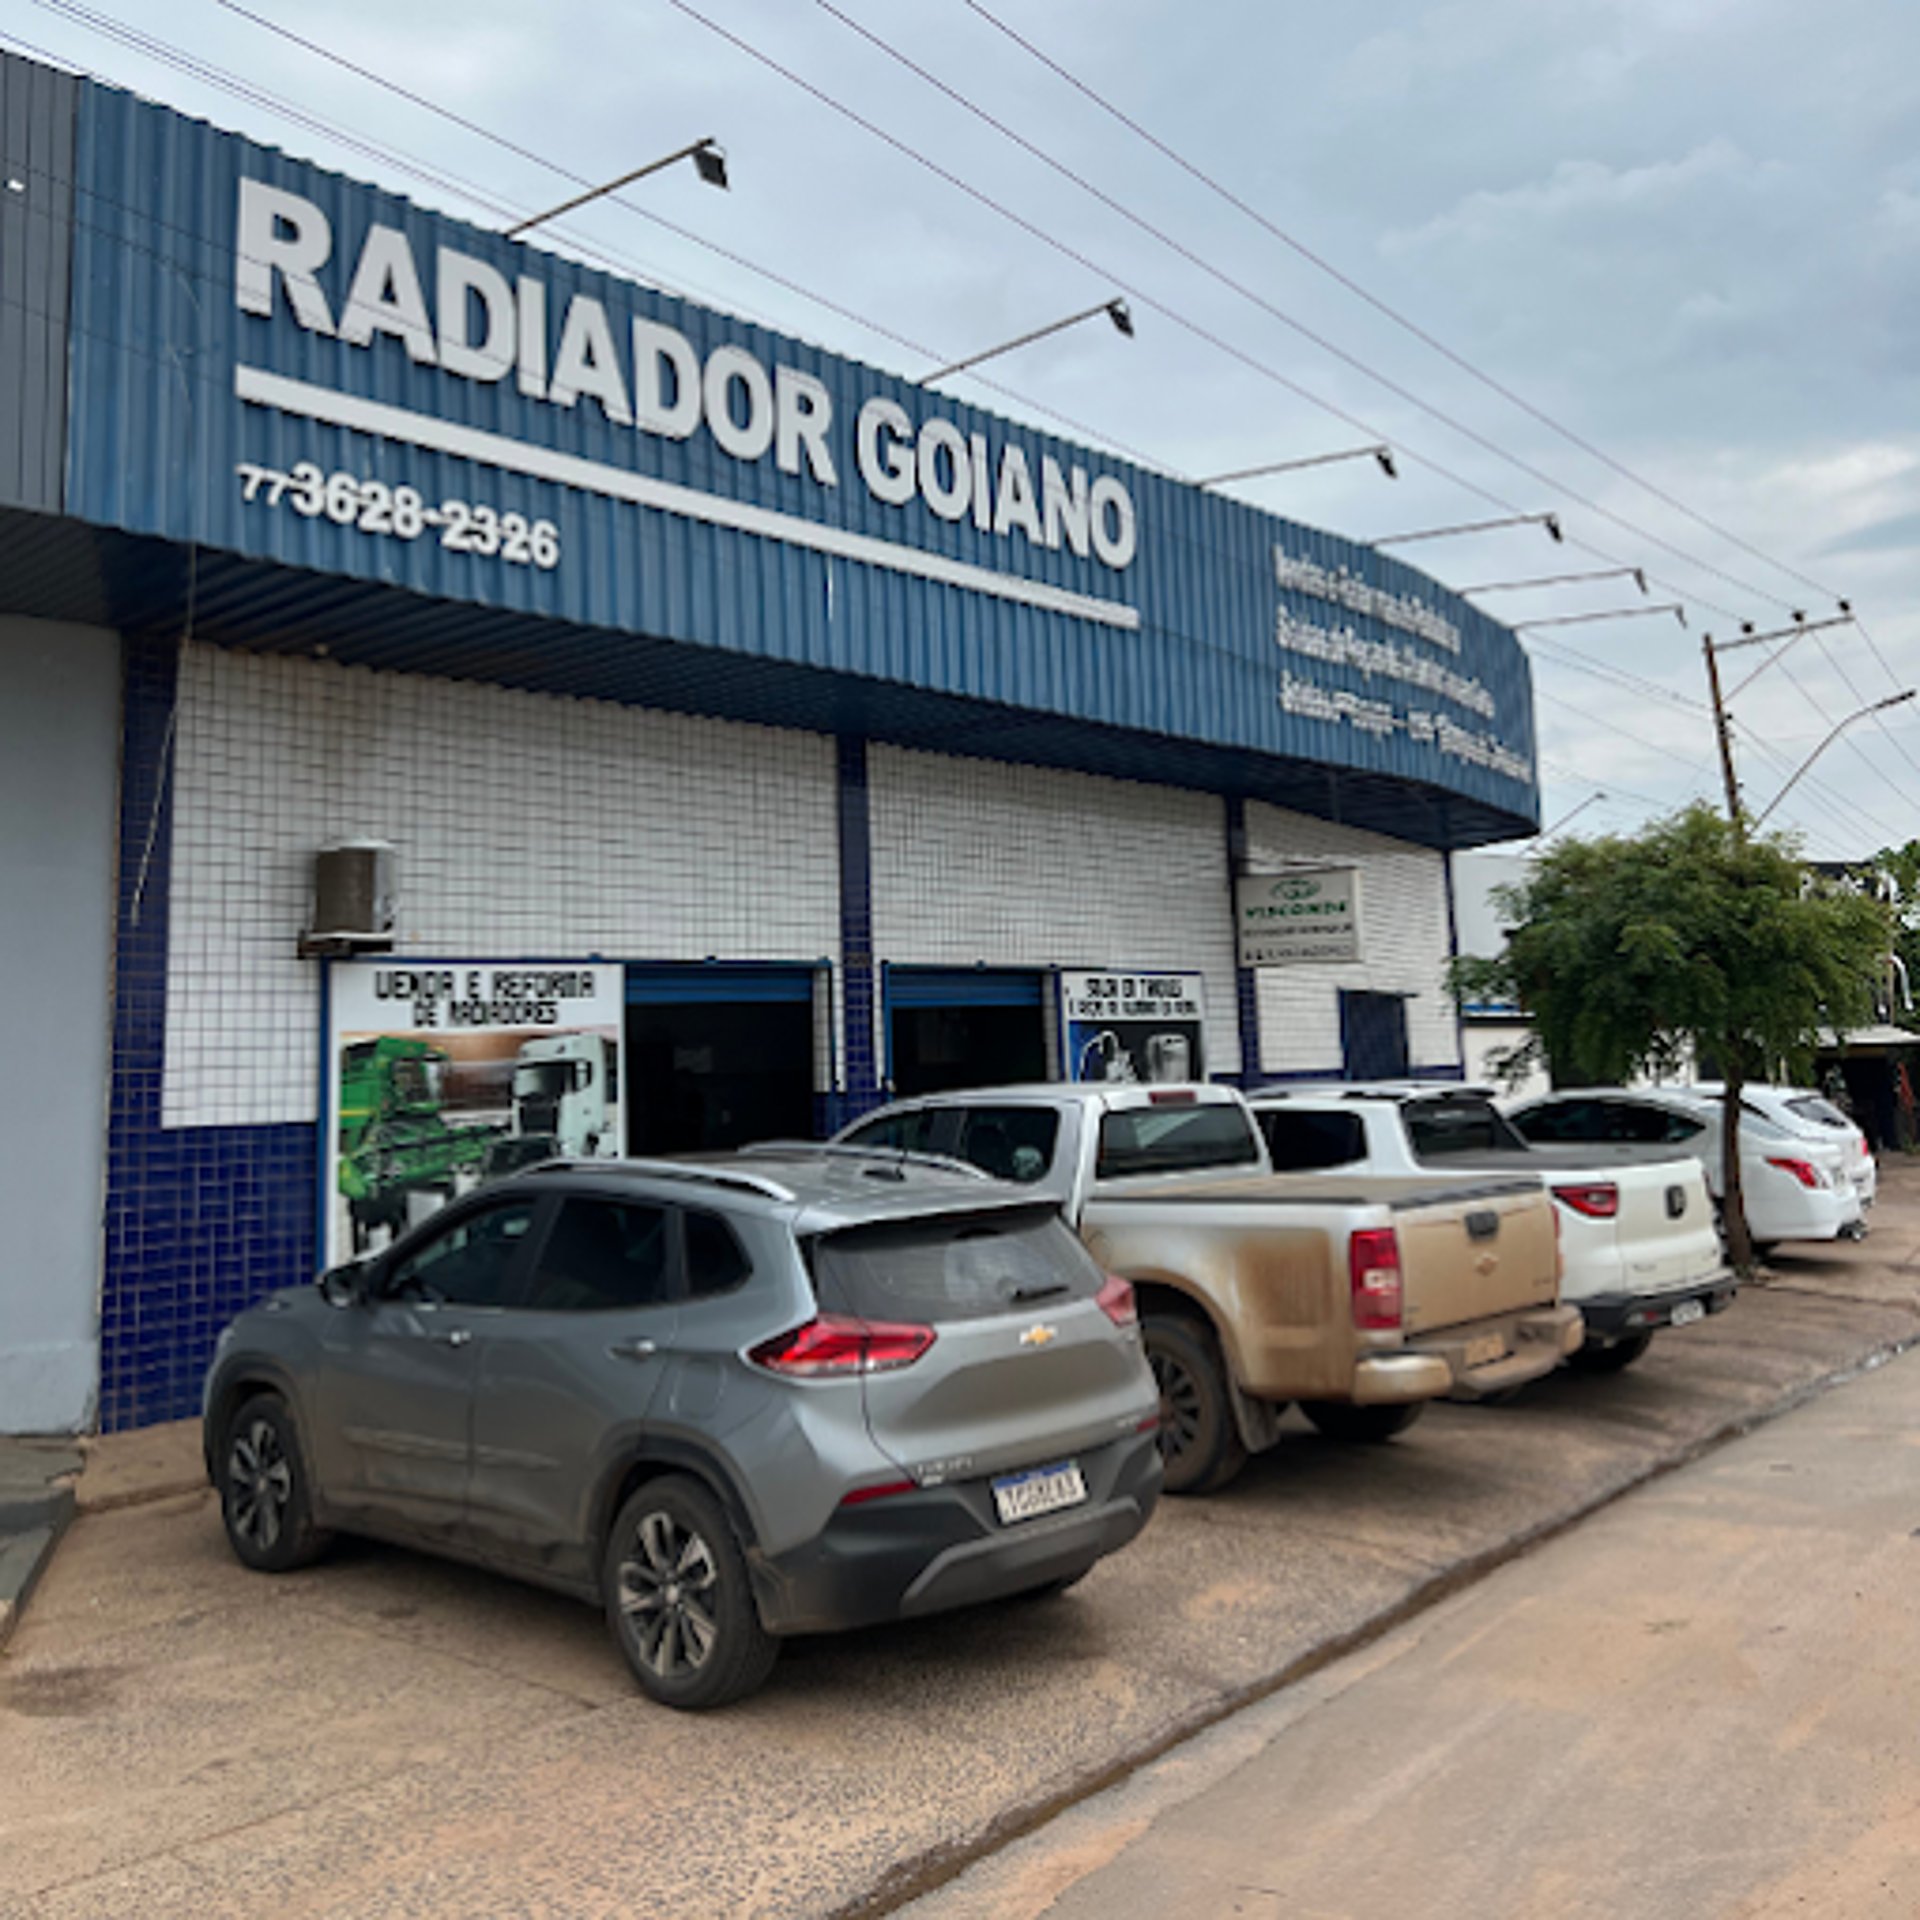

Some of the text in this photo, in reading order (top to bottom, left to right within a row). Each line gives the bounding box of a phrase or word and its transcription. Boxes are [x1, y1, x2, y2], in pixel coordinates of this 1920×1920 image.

[237, 177, 1136, 570] RADIADOR GOIANO
[466, 971, 479, 999] E
[493, 971, 596, 998] REFORMA
[413, 1001, 556, 1027] DE RADIADORES
